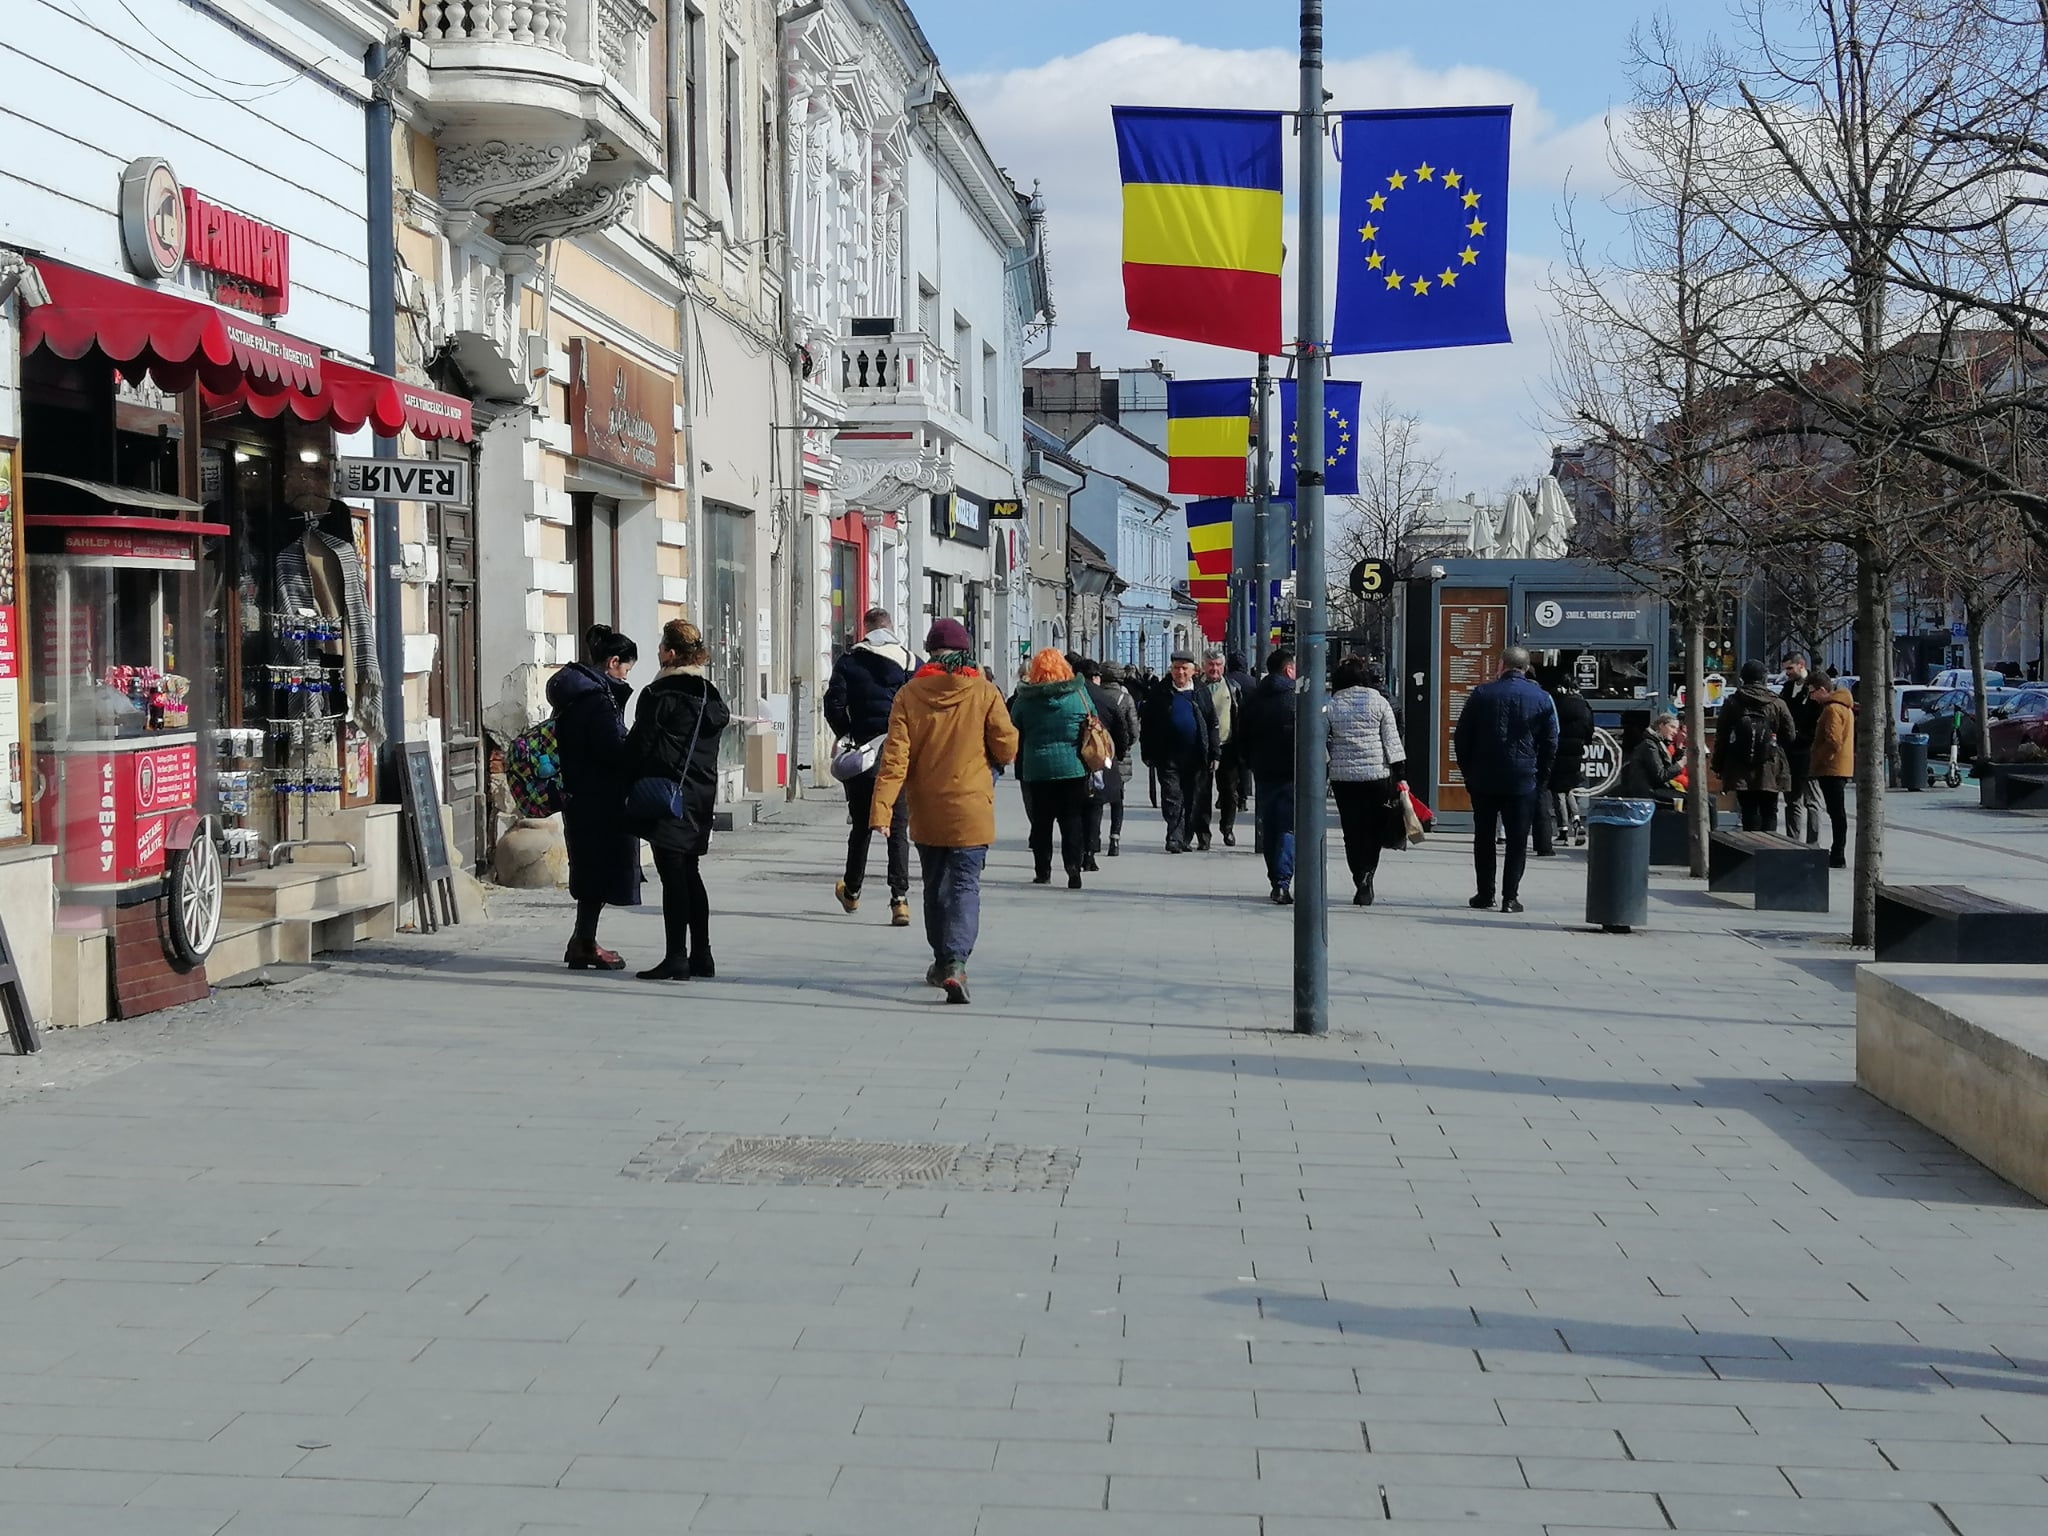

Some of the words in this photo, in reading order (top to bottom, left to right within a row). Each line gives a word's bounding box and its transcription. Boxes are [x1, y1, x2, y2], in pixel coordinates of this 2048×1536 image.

[181, 187, 289, 314] tramvay
[227, 325, 255, 348] CASTANE
[347, 464, 361, 491] CAFFE
[994, 502, 1018, 516] NP
[66, 537, 110, 548] SAHLEP
[1362, 563, 1382, 590] 5
[1361, 590, 1371, 599] to
[1372, 592, 1383, 601] go
[1543, 605, 1554, 619] 5
[99, 762, 116, 872] tramvay
[138, 819, 162, 849] CASTANE
